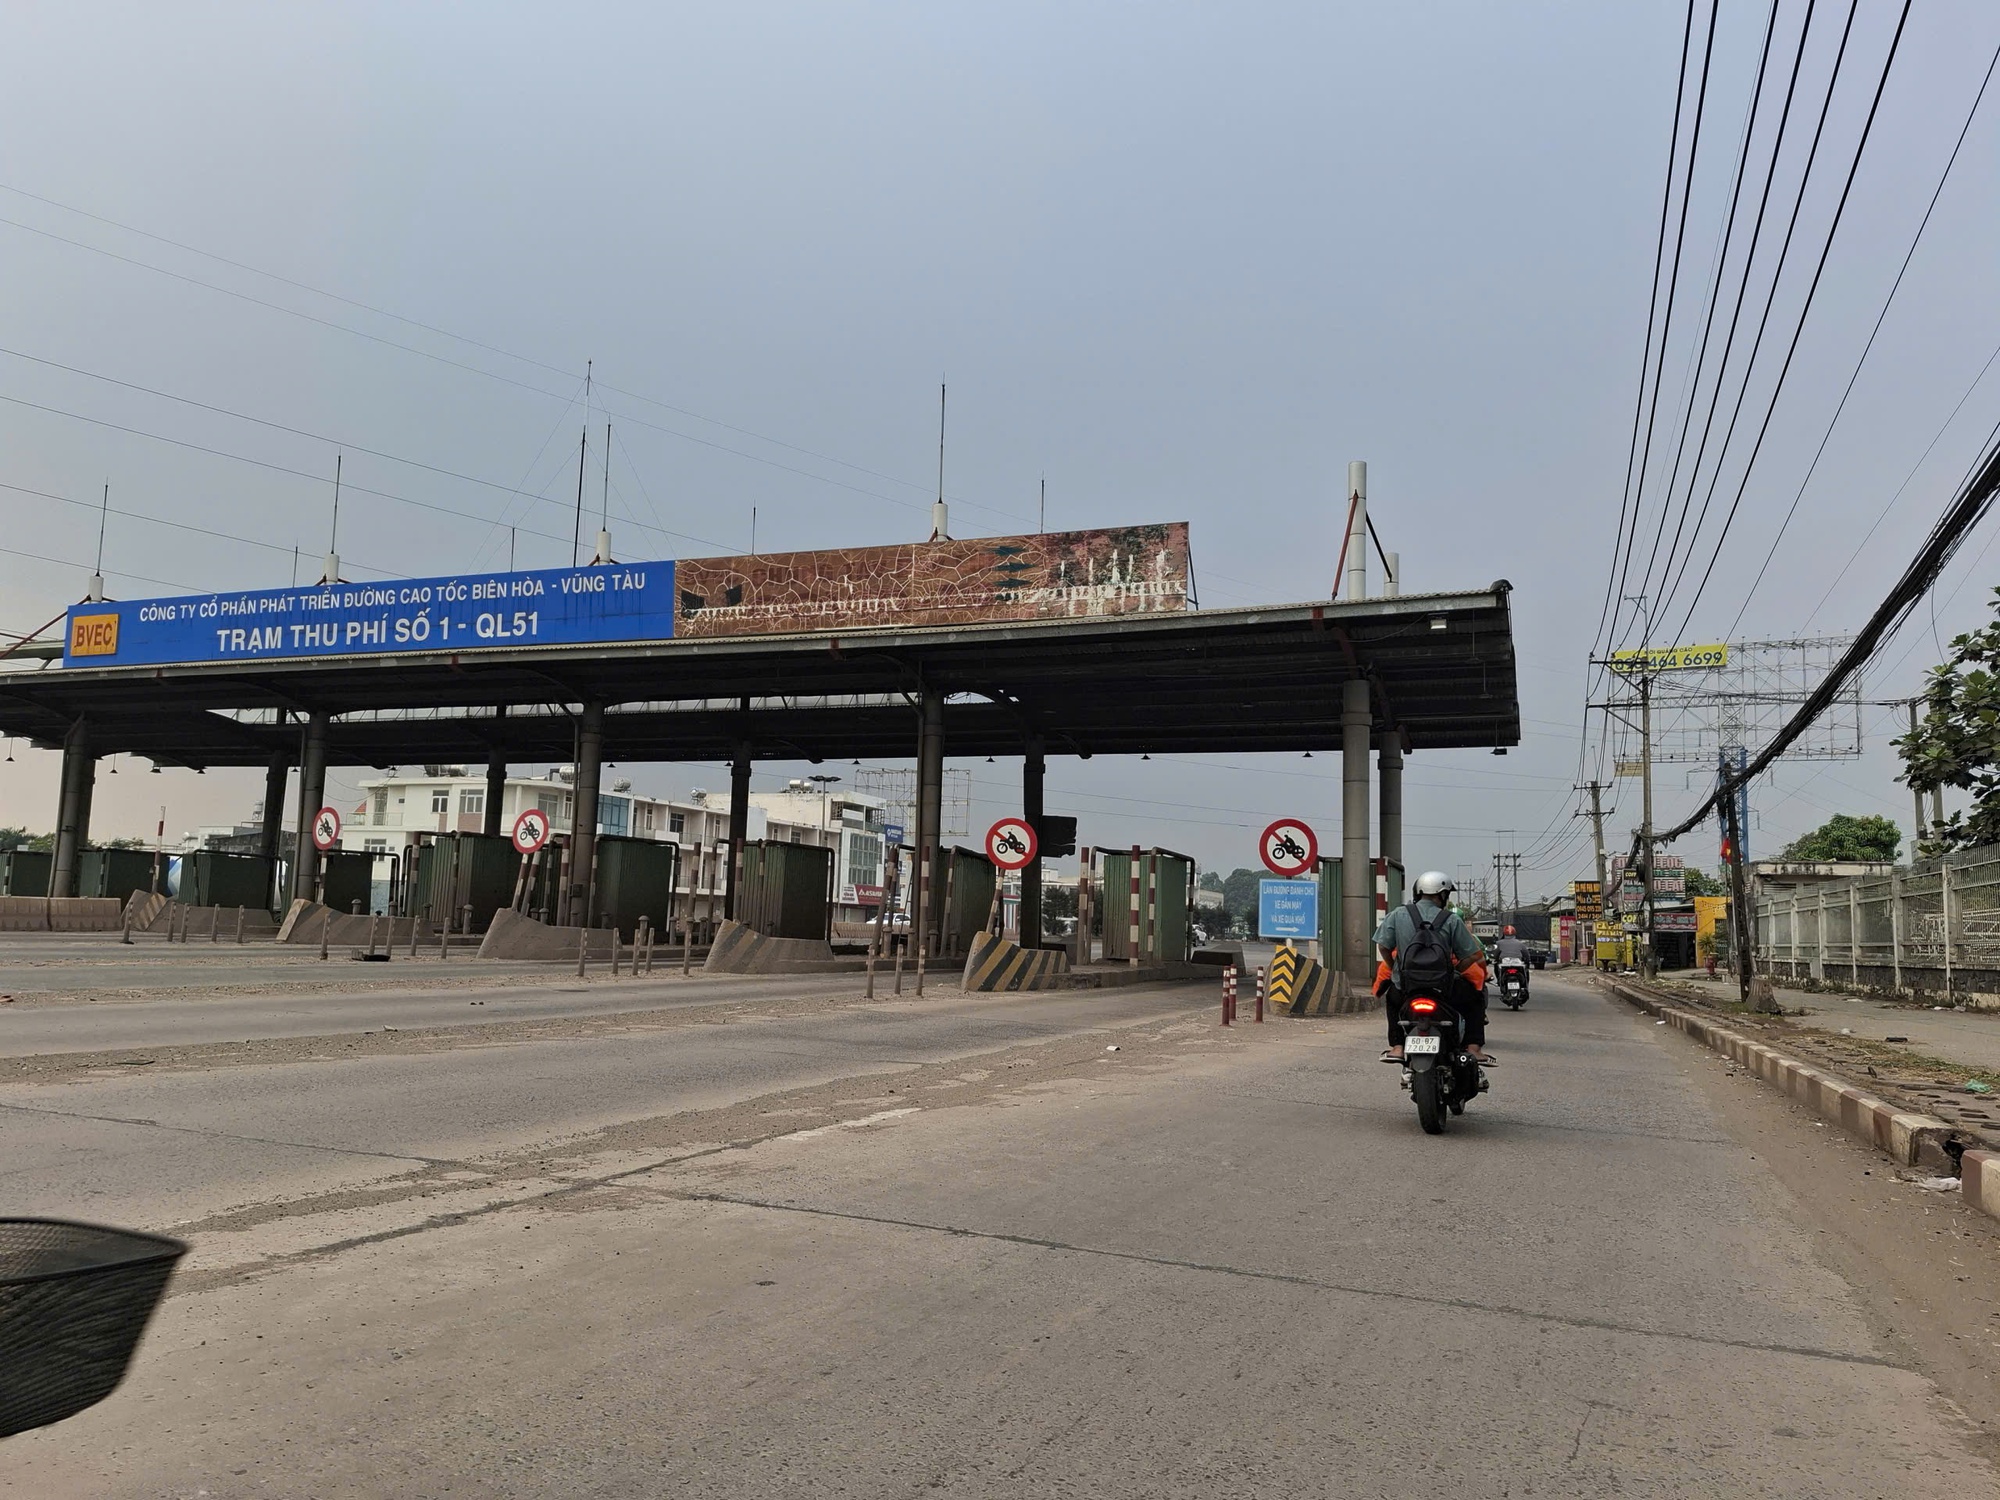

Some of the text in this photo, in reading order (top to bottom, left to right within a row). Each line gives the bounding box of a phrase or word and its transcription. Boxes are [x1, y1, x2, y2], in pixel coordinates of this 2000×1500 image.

[140, 603, 175, 622] CÔNG
[180, 604, 196, 618] TY
[200, 595, 217, 618] CỔ
[221, 597, 257, 616] PHẦN
[260, 594, 295, 613] PHÁT
[300, 587, 340, 610] TRIỂN
[344, 586, 395, 608] ĐƯỜNG
[400, 586, 431, 604] CAO
[436, 579, 467, 602] TỐC
[472, 579, 508, 599] BIÊN
[511, 575, 544, 597] HÒA
[560, 573, 605, 594] VŨNG
[612, 569, 645, 590] TÀU
[75, 621, 113, 647] BVEC
[216, 626, 281, 654] TRẠM
[290, 623, 337, 647] THU
[345, 609, 387, 645] PHÍ
[394, 607, 431, 642] SỐ
[440, 617, 448, 640] 1
[476, 611, 538, 638] QL51
[1649, 654, 1678, 668] 464
[1683, 651, 1723, 666] 6699
[1263, 884, 1314, 896] LÀN ĐƯỜNG DÀNH CHO
[1275, 897, 1302, 910] XE GẮN MÁY
[1271, 912, 1306, 925] VÀ XE QUÁ KHỔ
